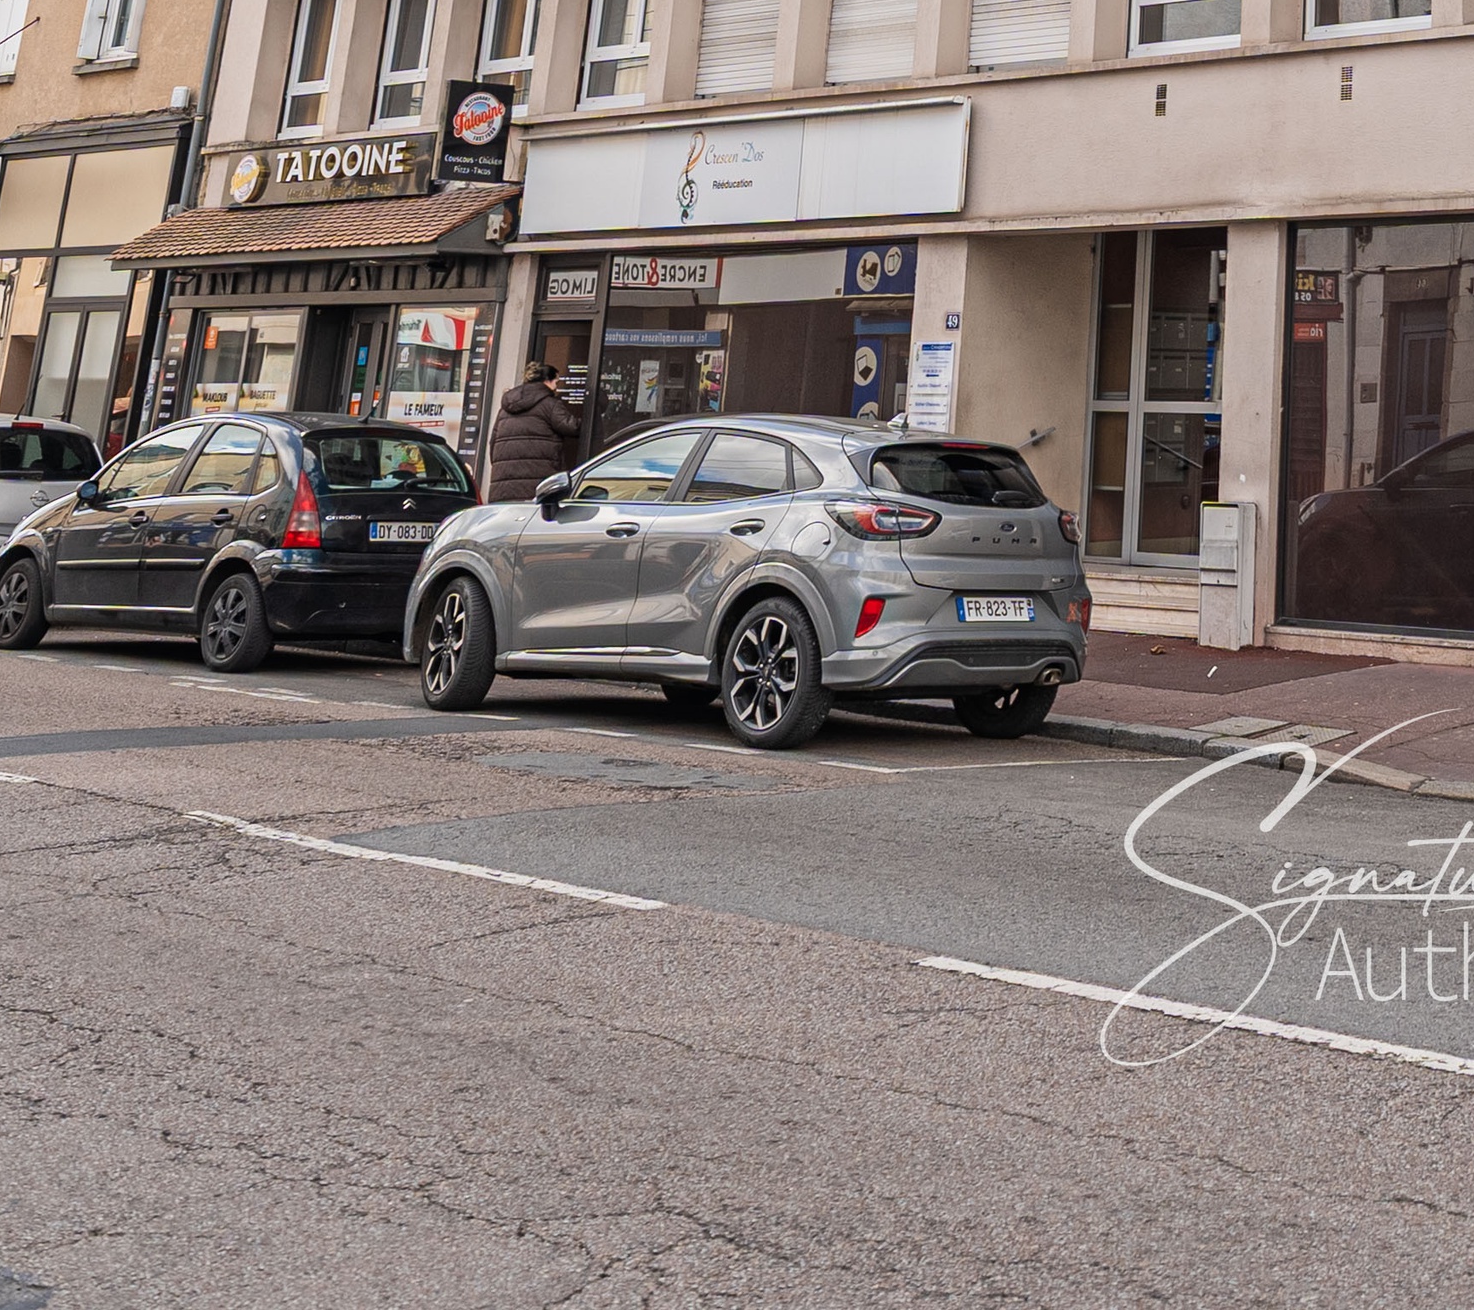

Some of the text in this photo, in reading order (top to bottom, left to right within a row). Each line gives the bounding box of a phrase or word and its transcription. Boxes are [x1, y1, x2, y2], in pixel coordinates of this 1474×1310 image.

[276, 140, 407, 183] TATOOINE
[712, 179, 753, 190] Rééducation
[947, 315, 958, 328] 49
[404, 403, 445, 417] LE FAMEUX
[378, 525, 434, 539] DY-083-DD
[966, 600, 1025, 617] FR-823-TF
